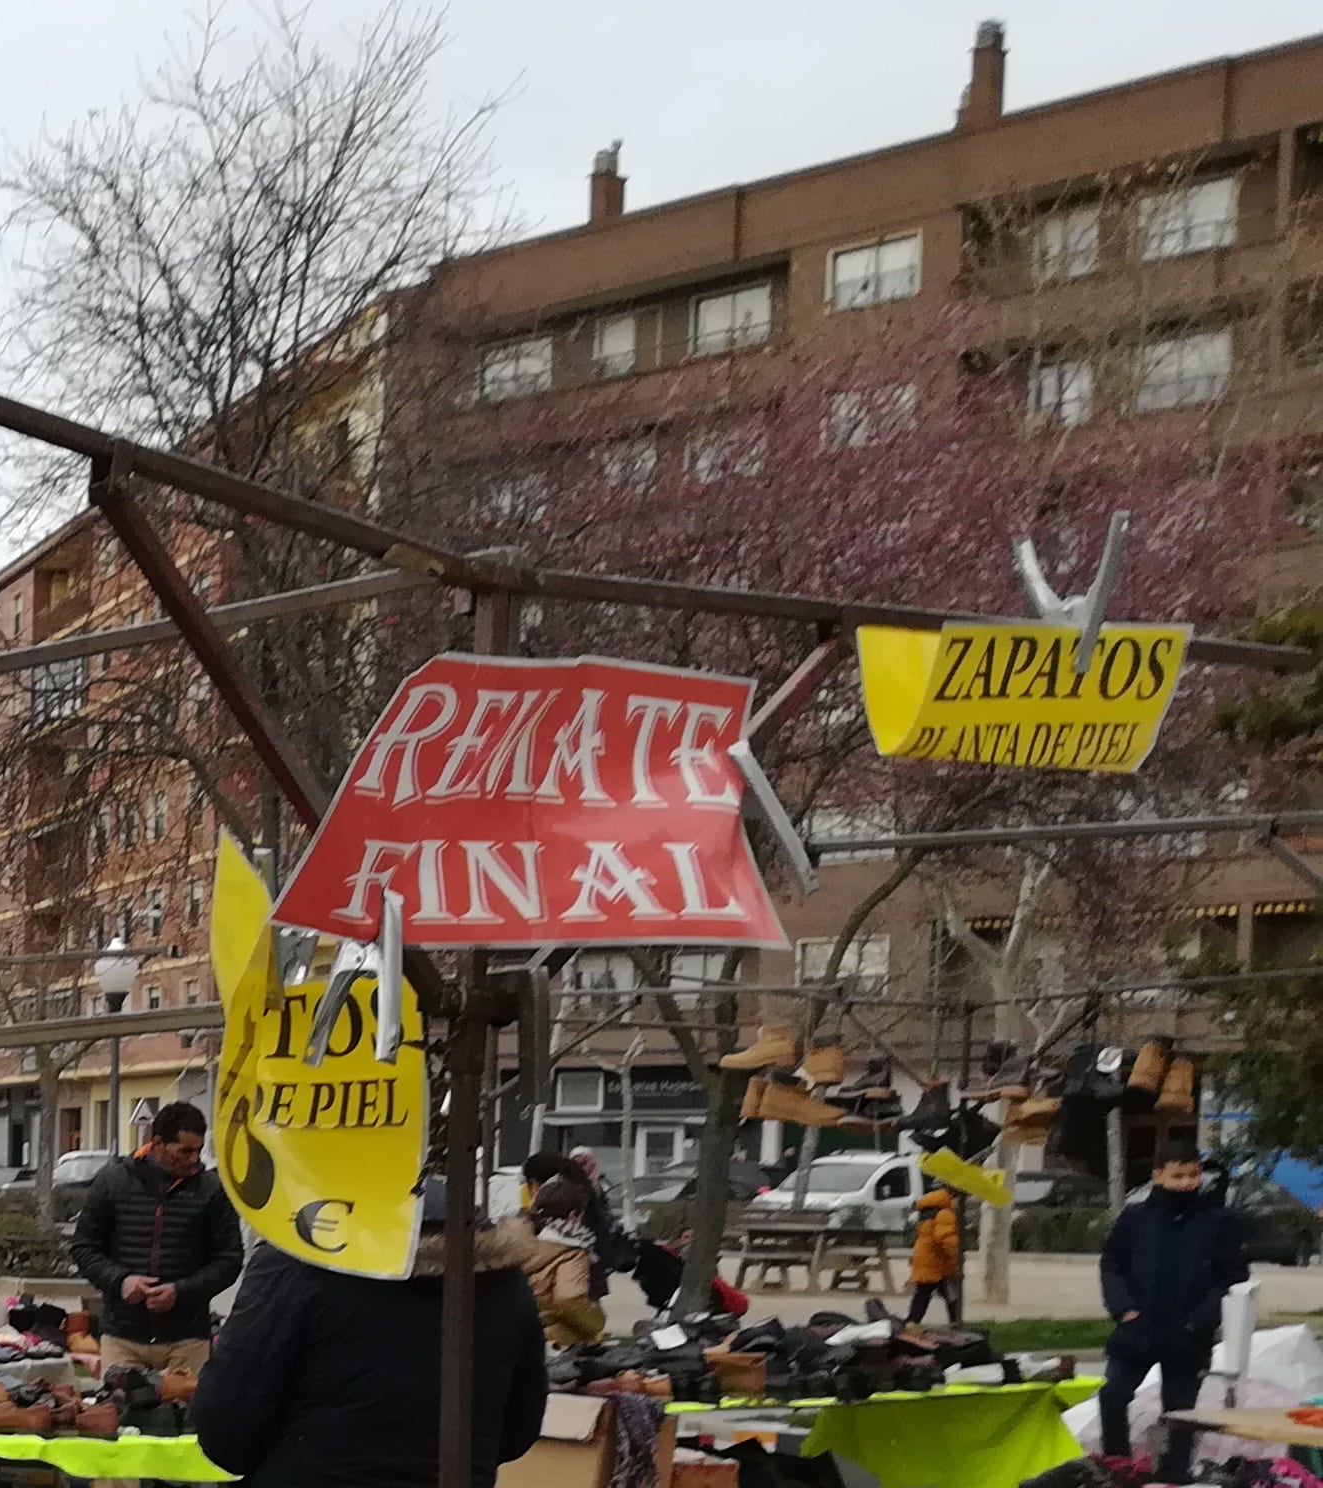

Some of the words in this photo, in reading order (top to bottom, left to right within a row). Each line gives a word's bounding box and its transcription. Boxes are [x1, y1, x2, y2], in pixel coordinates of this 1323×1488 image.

[933, 636, 1173, 702] ZAPATOS
[1024, 722, 1075, 766] DE
[1069, 722, 1141, 767] PIEL
[329, 839, 749, 925] FINAL
[302, 1078, 409, 1128] PIEL
